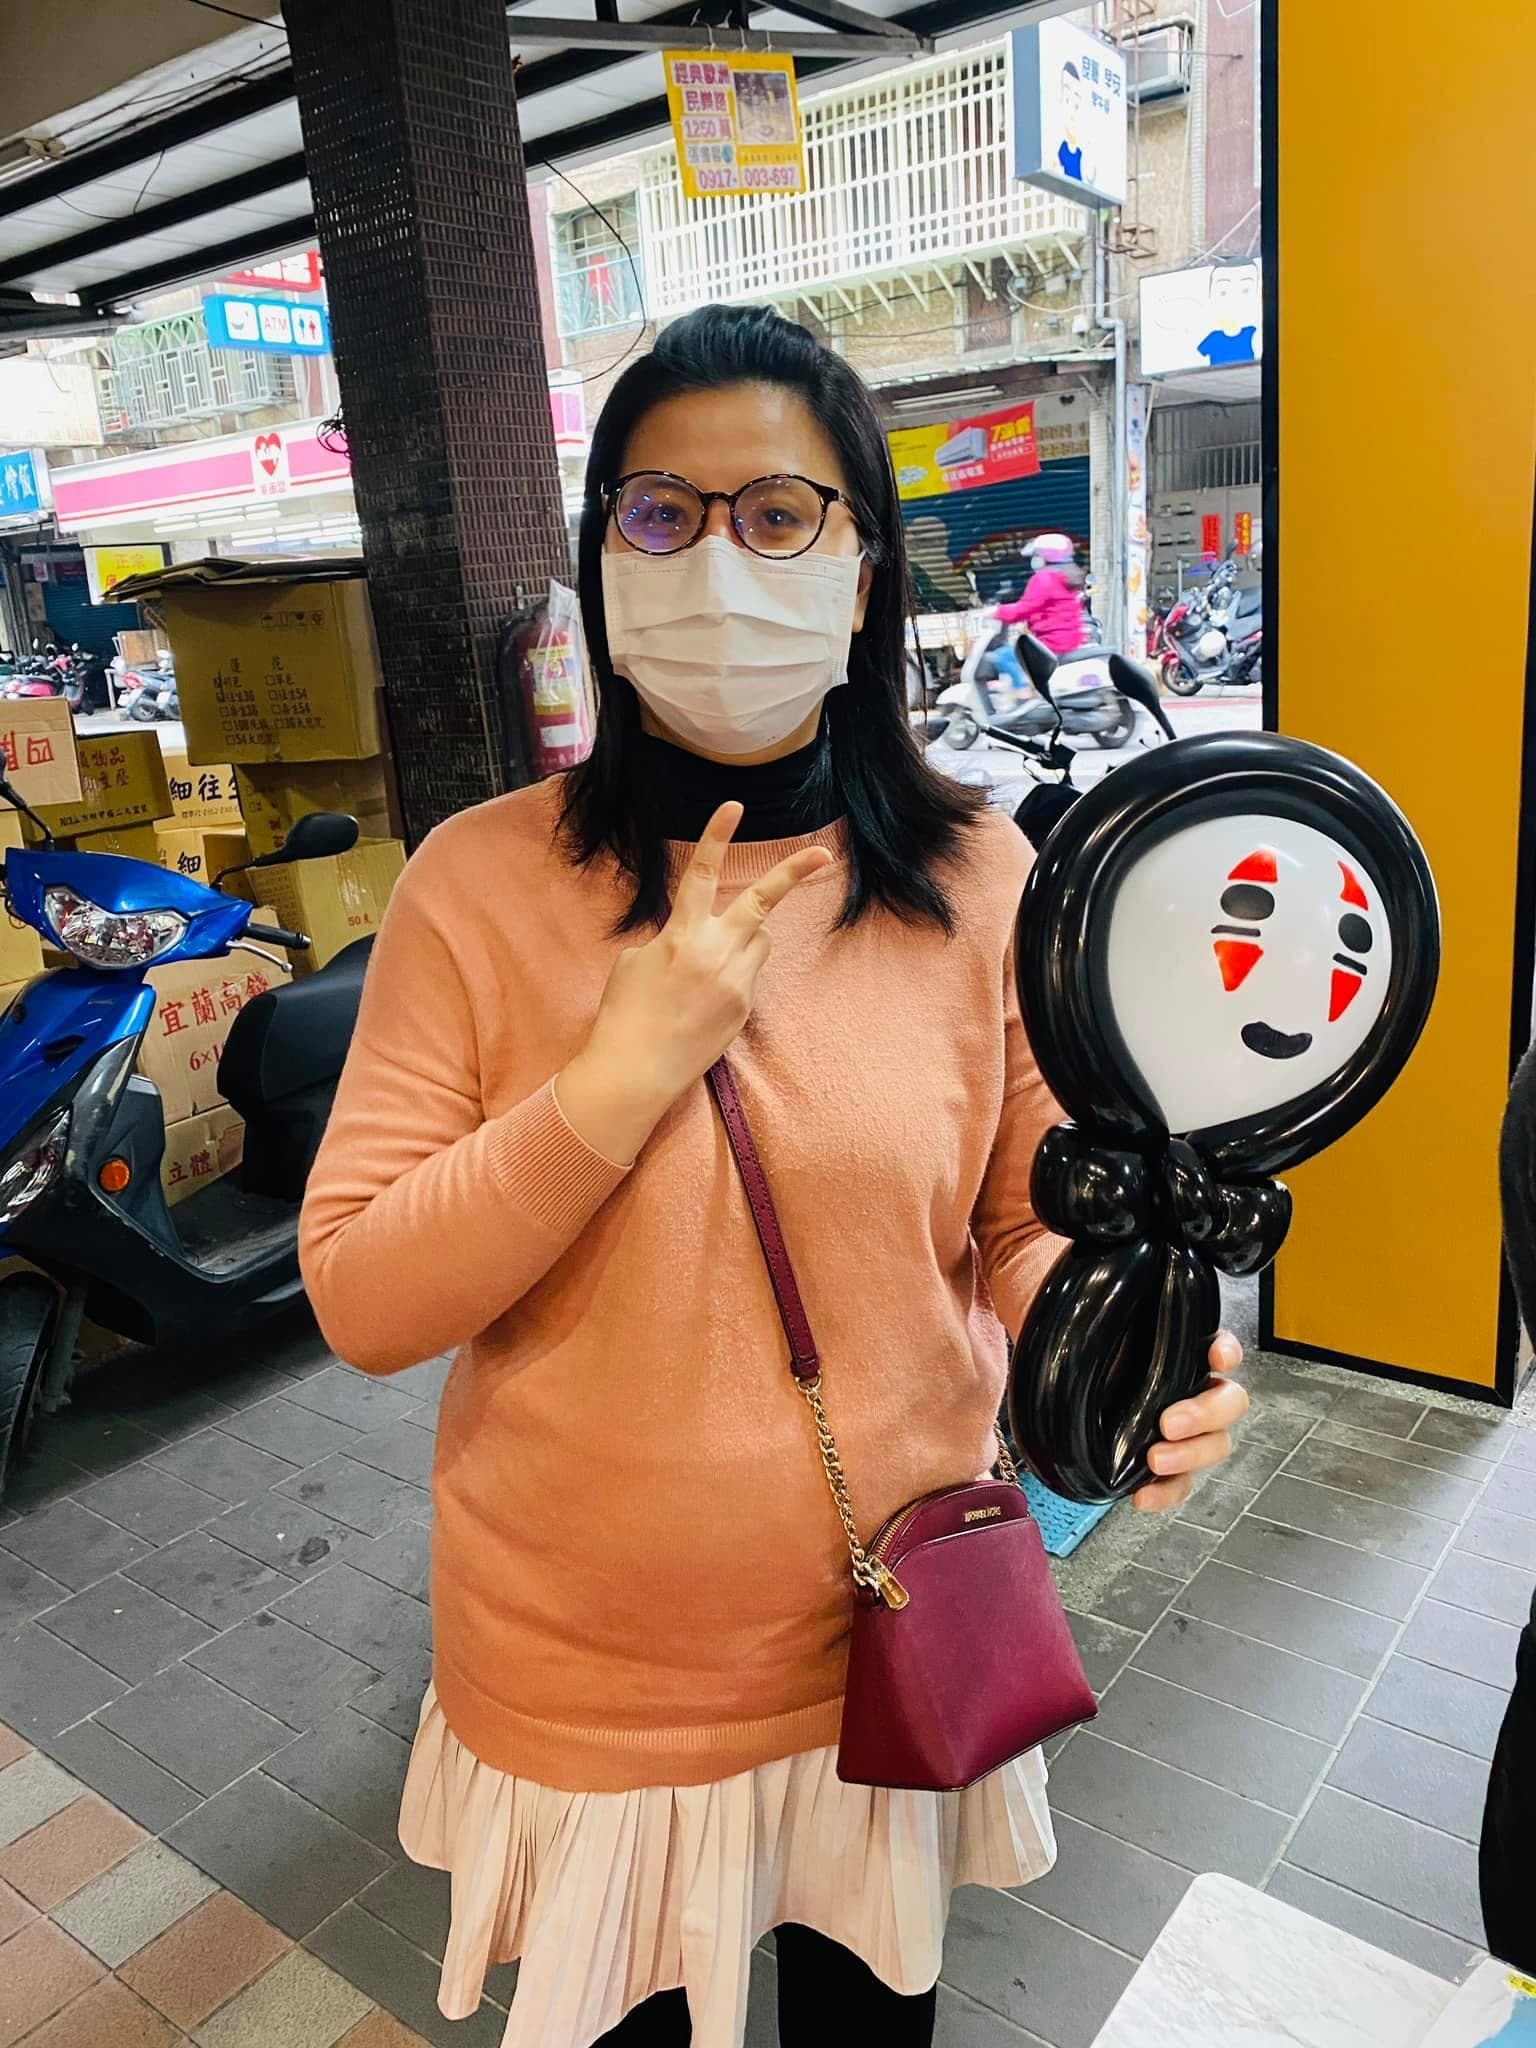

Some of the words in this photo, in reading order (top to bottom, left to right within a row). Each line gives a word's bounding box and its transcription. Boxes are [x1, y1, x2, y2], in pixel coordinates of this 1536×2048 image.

[684, 119, 716, 138] 1250
[263, 315, 288, 331] ATM
[177, 850, 201, 874] 細
